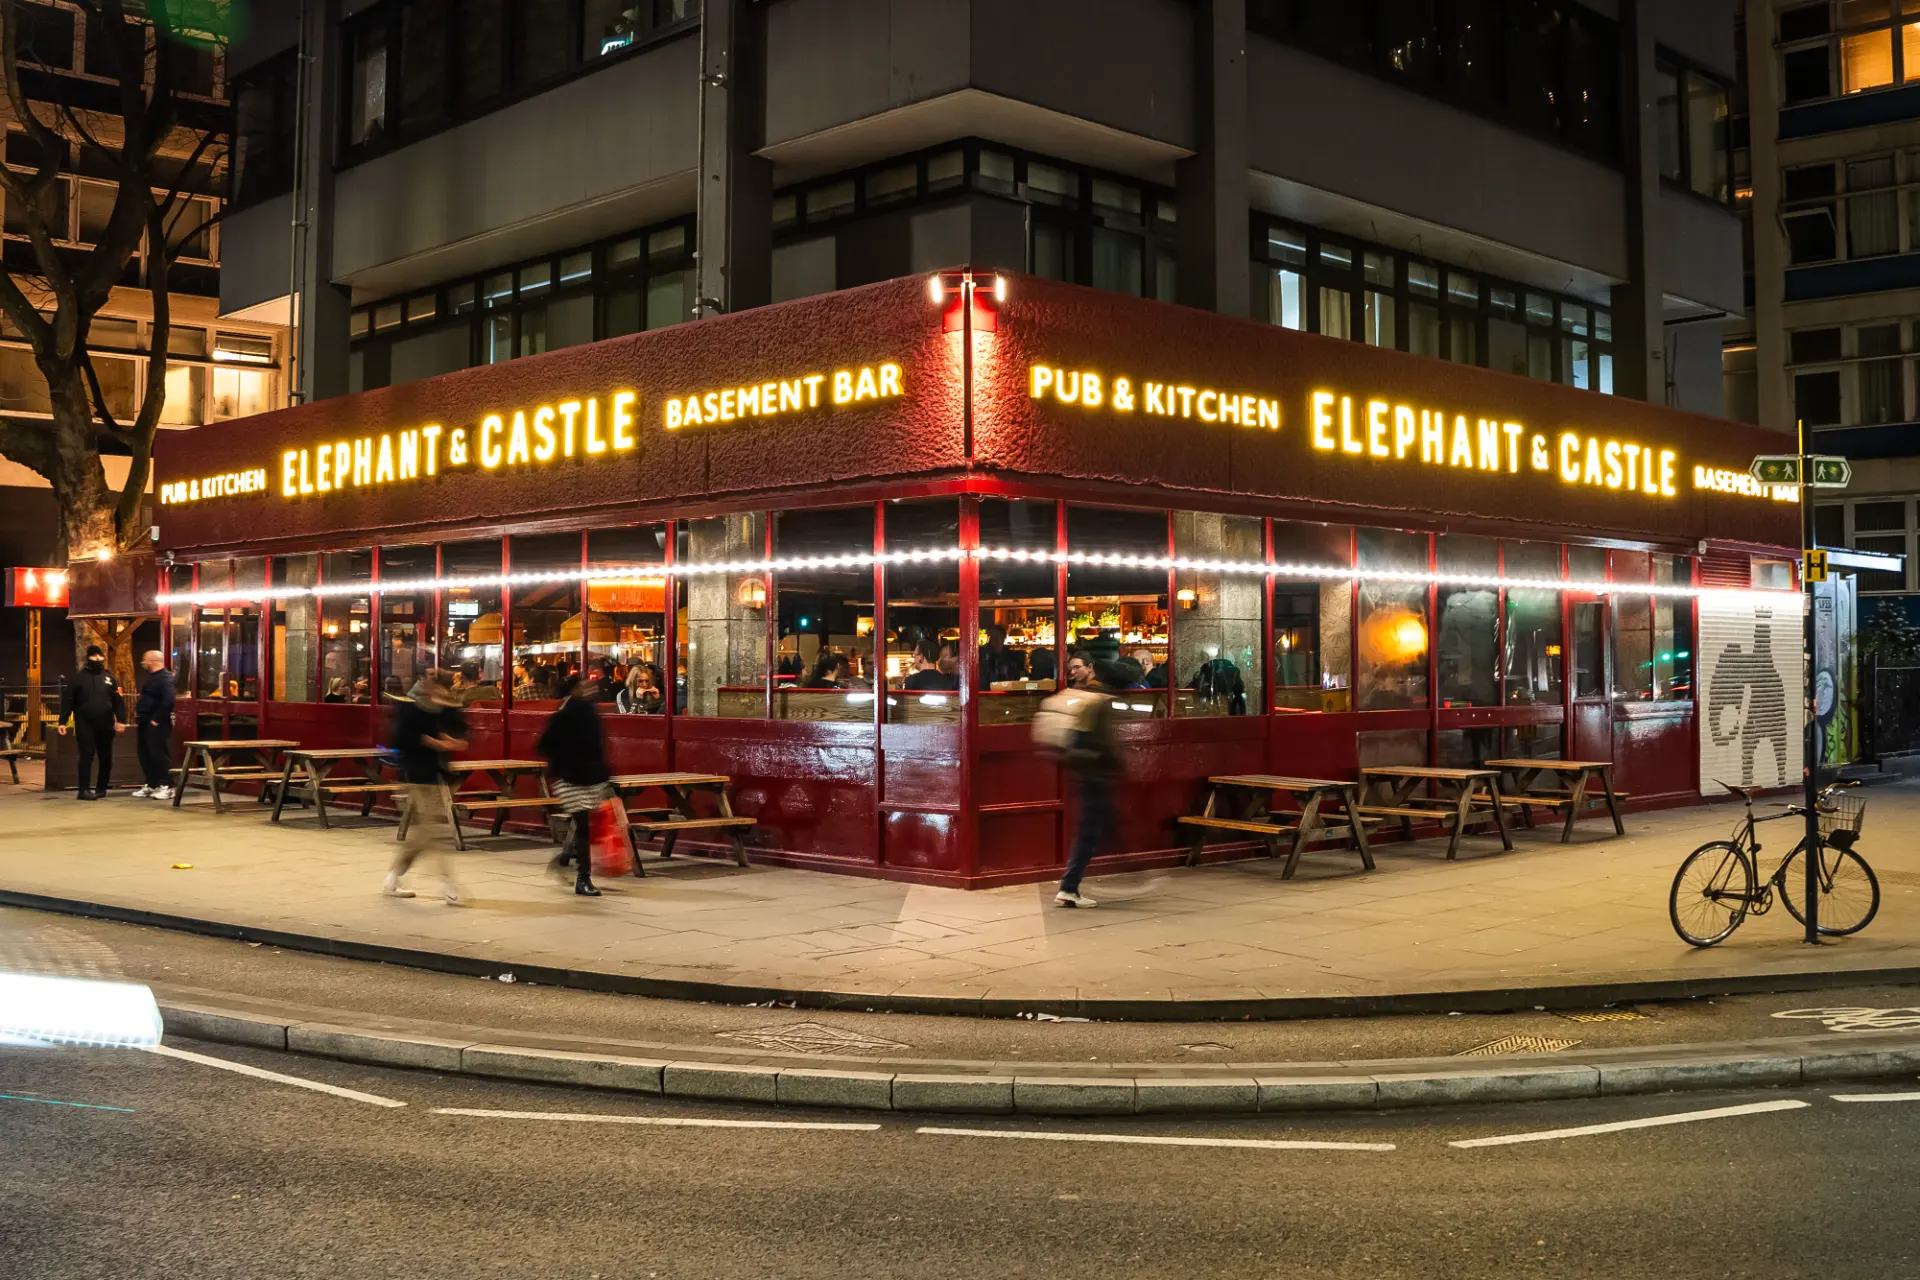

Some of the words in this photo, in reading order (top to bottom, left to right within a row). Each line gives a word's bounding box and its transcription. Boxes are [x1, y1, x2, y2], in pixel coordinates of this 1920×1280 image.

[663, 373, 826, 431] BASEMENT
[831, 361, 906, 406] BAR
[1029, 364, 1105, 408] PUB
[1112, 376, 1136, 412] &
[1144, 381, 1281, 431] KITCHEN
[280, 423, 443, 498] ELEPHANT
[448, 426, 469, 467] &
[478, 388, 637, 470] CASTLE
[1310, 389, 1525, 474] ELEPHANT
[1530, 434, 1551, 471] &
[1557, 430, 1678, 499] CASTLE
[160, 480, 189, 505] PUB
[189, 478, 201, 501] &
[201, 467, 267, 499] KITCHEN
[1806, 552, 1825, 579] H
